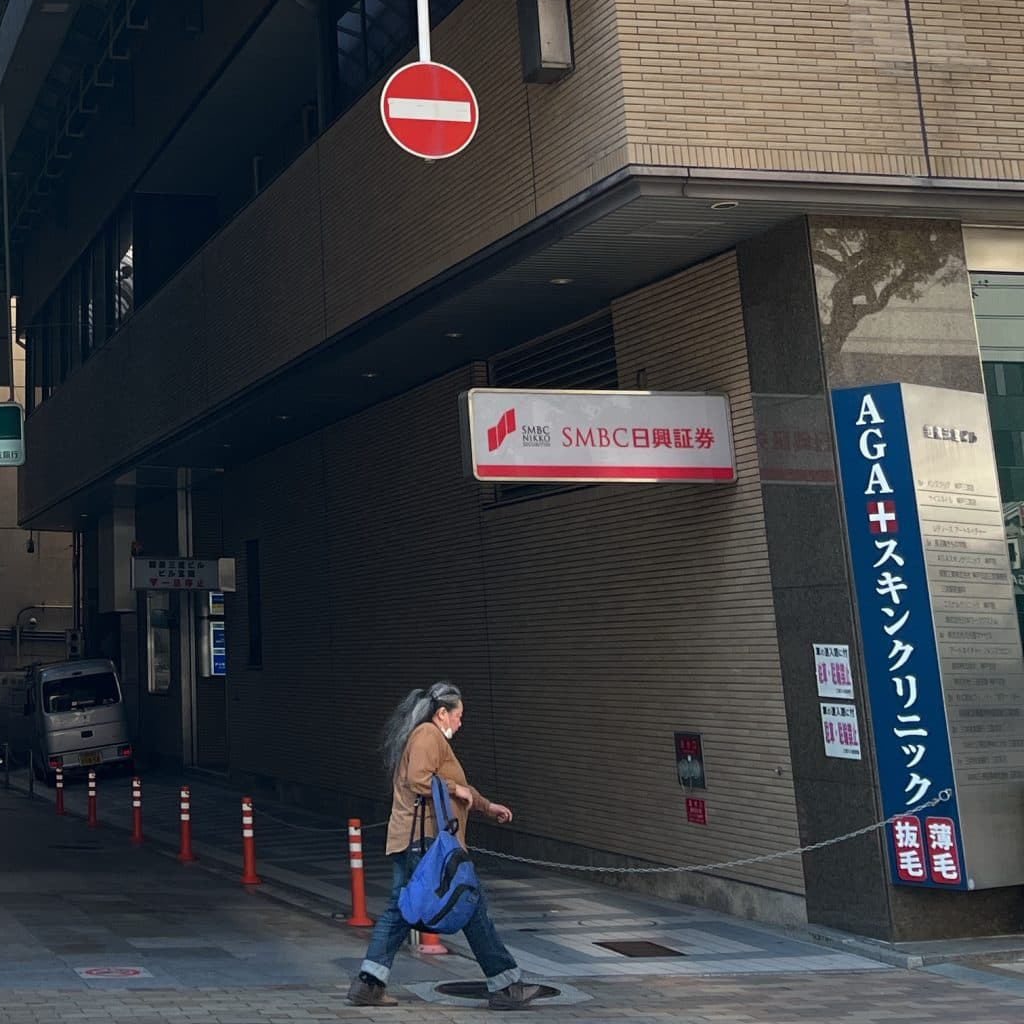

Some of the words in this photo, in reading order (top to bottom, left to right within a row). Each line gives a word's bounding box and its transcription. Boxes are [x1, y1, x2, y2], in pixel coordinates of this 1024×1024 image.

[522, 425, 550, 435] SMBC
[522, 434, 551, 443] NIKKO
[562, 427, 715, 450] SMBC日興証券
[855, 393, 894, 495] AGA
[873, 539, 932, 805] スキンクリニック
[894, 821, 924, 877] 抜毛
[927, 823, 959, 880] 薄毛
